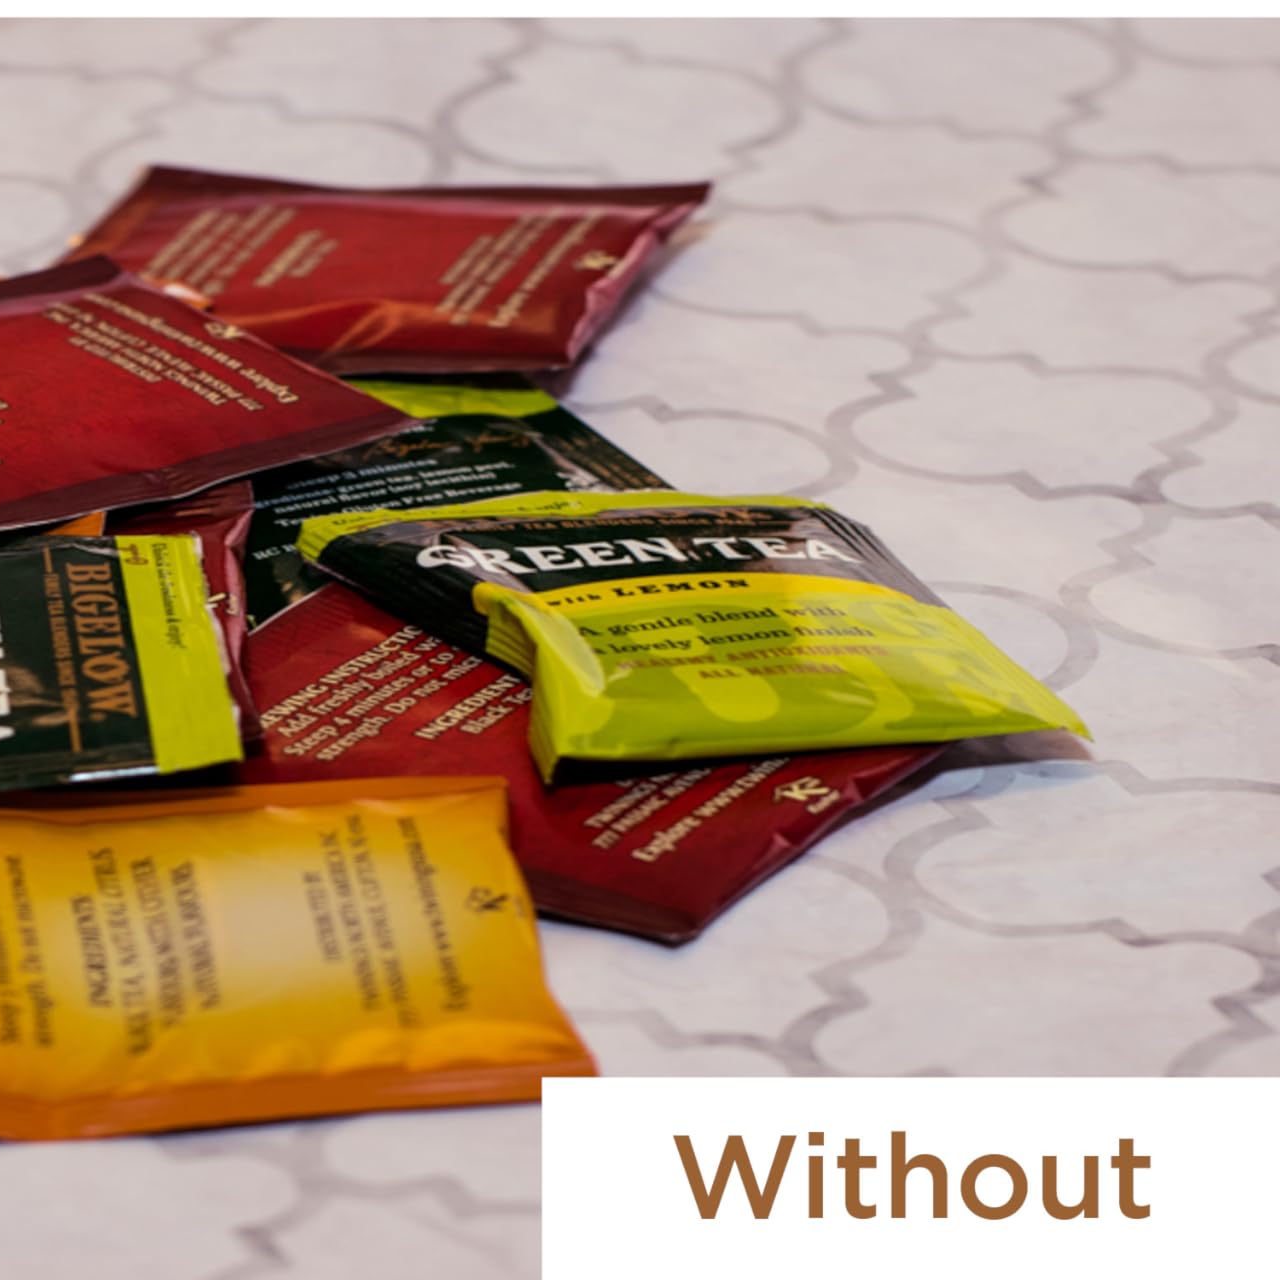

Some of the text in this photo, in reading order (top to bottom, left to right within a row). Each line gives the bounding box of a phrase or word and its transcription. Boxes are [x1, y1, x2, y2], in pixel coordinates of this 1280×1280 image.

[337, 467, 472, 494] green lemon
[442, 481, 523, 500] Beverage
[274, 494, 337, 514] natural
[338, 485, 386, 502] flavor
[416, 536, 862, 576] GREEN TEA
[546, 578, 751, 608] with LEMON
[47, 599, 72, 658] TEA BLENDERS
[580, 606, 847, 637] A gentle blend with
[65, 559, 134, 722] BIGELOW
[613, 625, 875, 655] lovely lemon finish
[254, 626, 424, 725] EWING INSTRUCTIO
[697, 664, 848, 680] ALL NATURAL
[273, 650, 420, 736] Add freshly boiled
[281, 723, 342, 756] Steep
[343, 675, 416, 716] minutes
[408, 663, 436, 677] or
[427, 650, 457, 665] to
[381, 695, 419, 714] Do
[410, 678, 447, 697] not
[413, 675, 523, 738] INGREDIENT
[457, 703, 515, 734] Black
[627, 816, 709, 861] Explore
